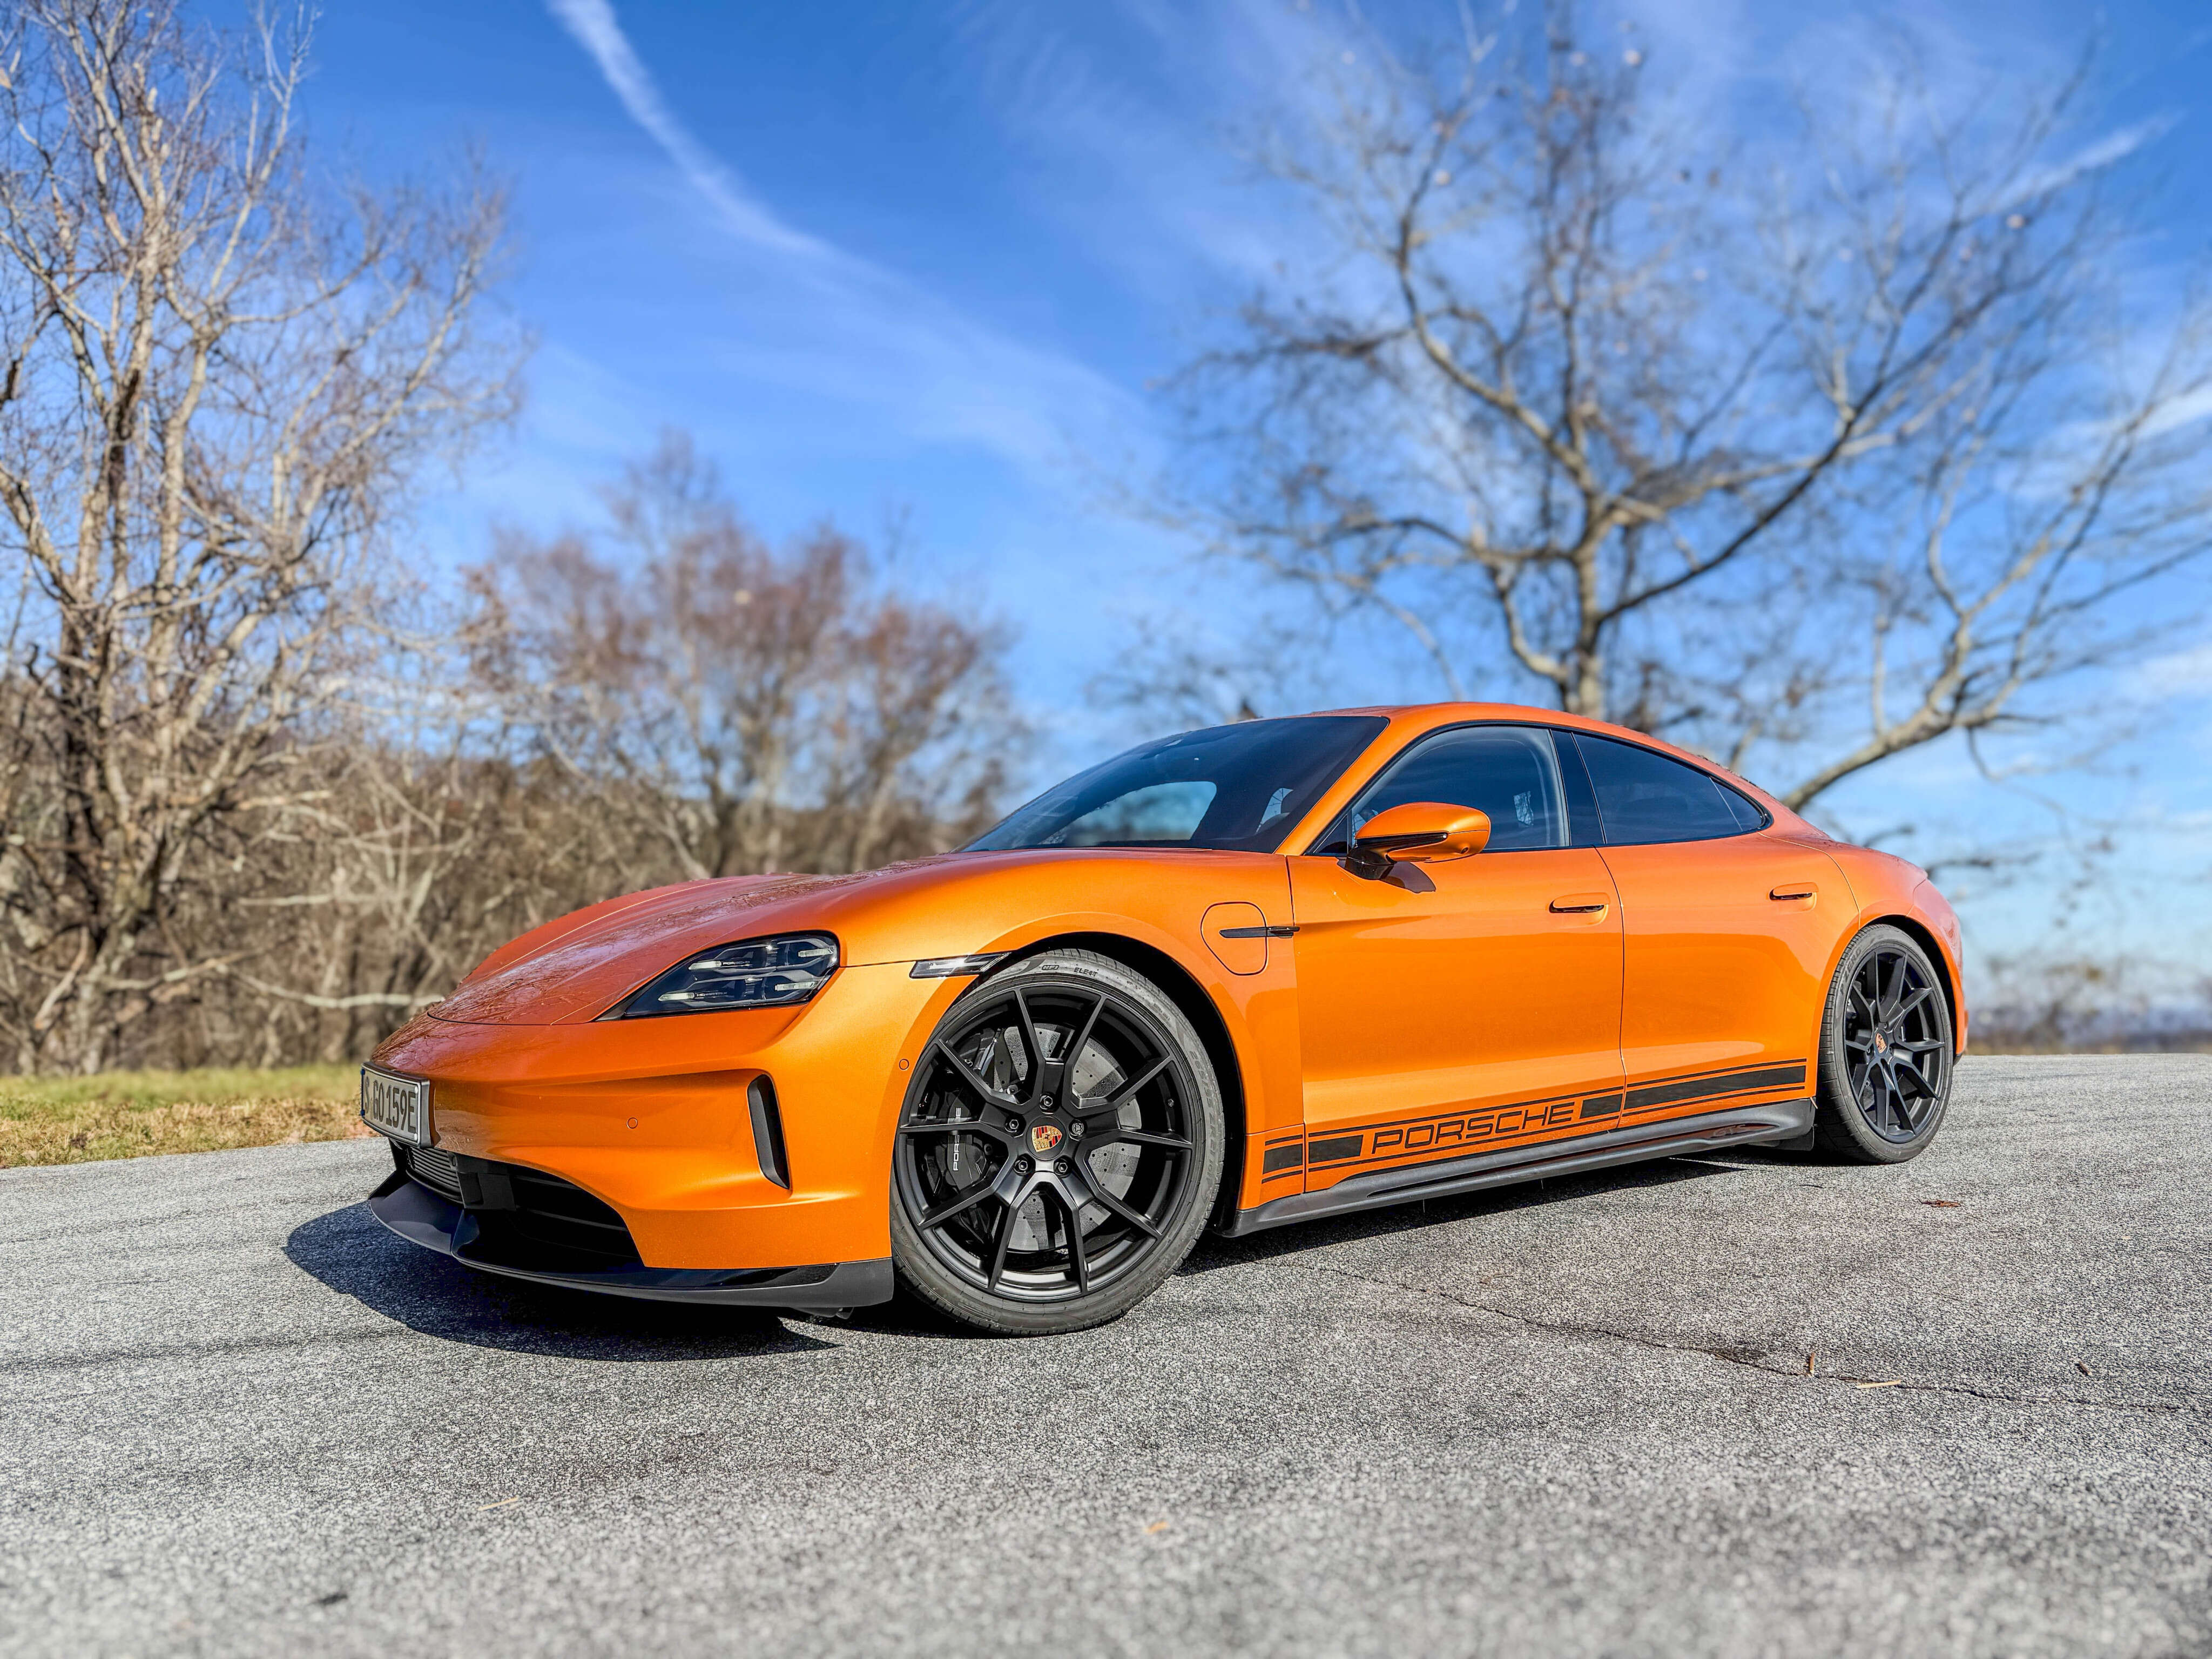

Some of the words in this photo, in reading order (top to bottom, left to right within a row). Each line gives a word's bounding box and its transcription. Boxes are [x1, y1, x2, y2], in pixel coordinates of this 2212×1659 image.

[364, 1076, 369, 1114] S
[373, 1080, 385, 1122] GO
[386, 1084, 416, 1134] 159E
[1372, 1102, 1575, 1155] PORSCHE
[953, 1107, 961, 1171] PORSE
